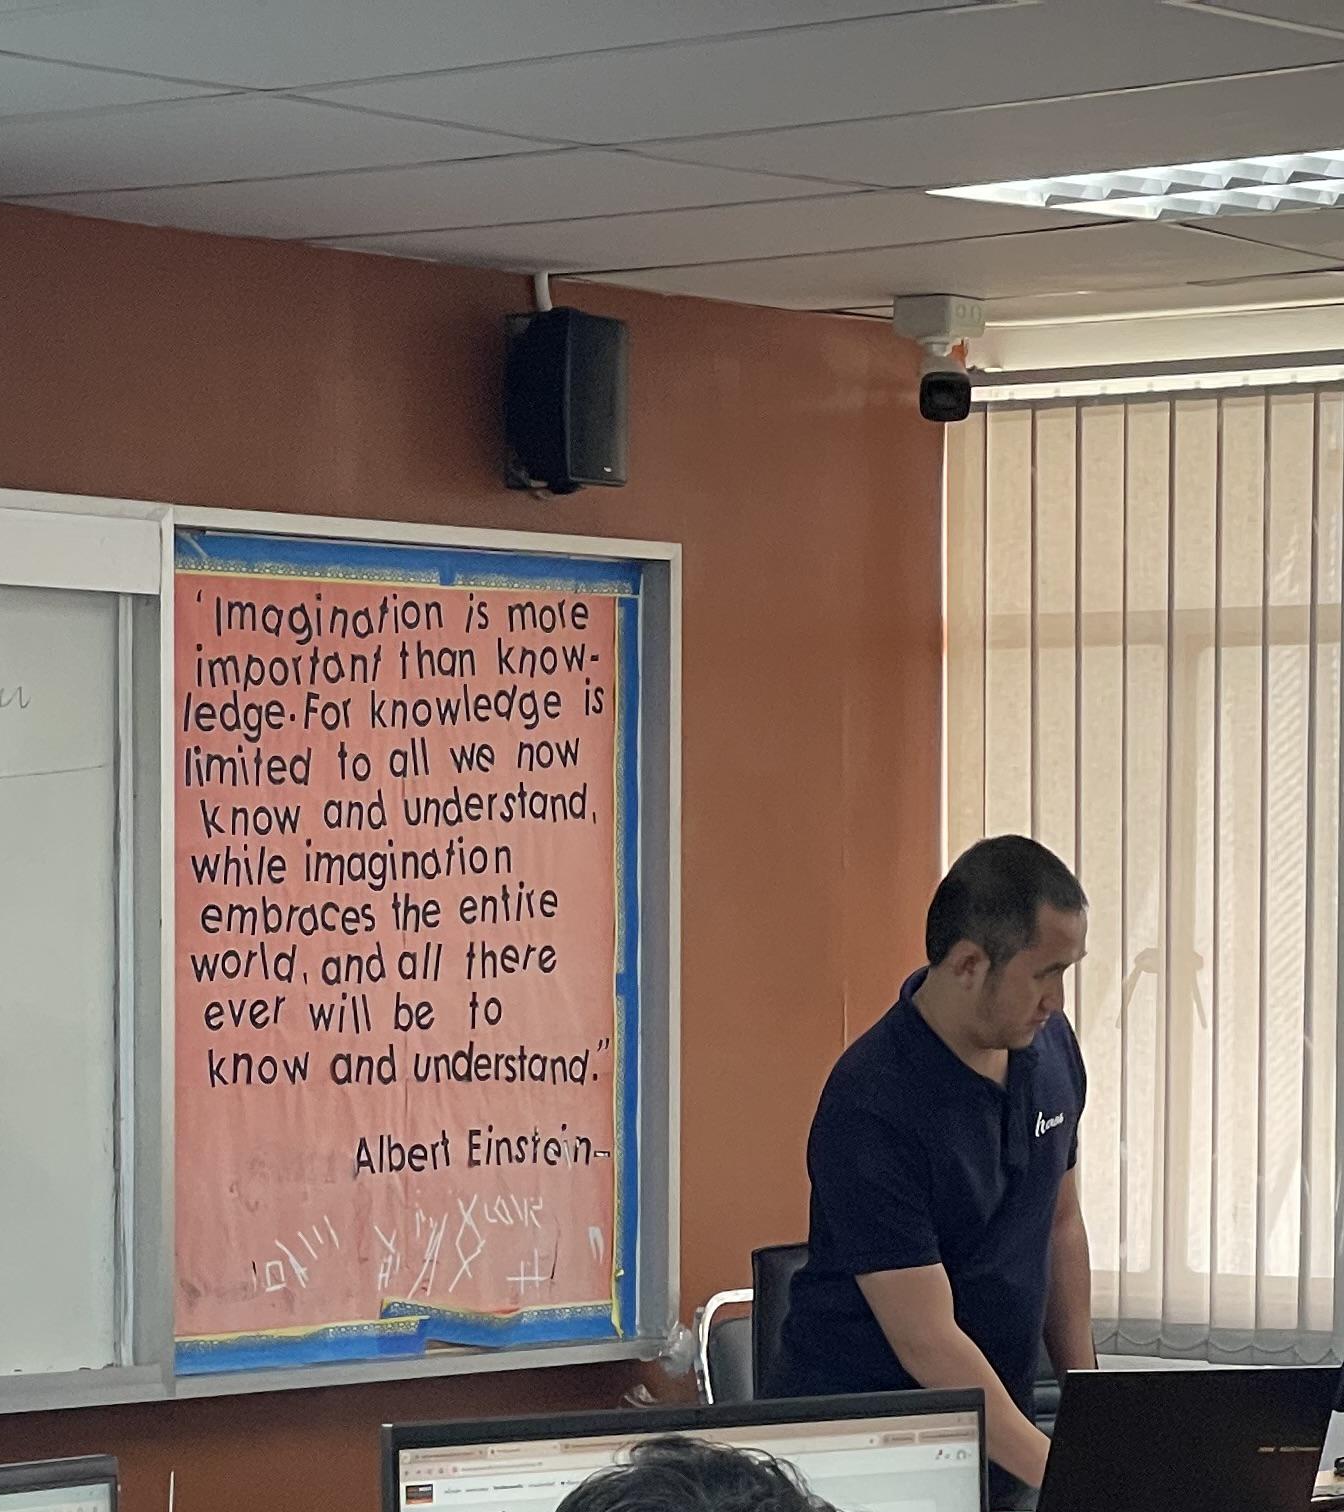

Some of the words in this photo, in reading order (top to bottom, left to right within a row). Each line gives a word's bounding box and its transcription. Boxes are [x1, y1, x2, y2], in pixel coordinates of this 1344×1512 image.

[465, 592, 489, 634] is
[507, 598, 589, 634] more
[196, 643, 382, 693] important
[399, 639, 476, 680] than
[497, 637, 600, 679] know-
[370, 683, 562, 730] knowledge
[585, 676, 605, 716] is
[185, 744, 312, 788] limited
[337, 741, 371, 782] to
[389, 736, 430, 778] all
[449, 742, 495, 774] we
[517, 737, 580, 772] now
[199, 799, 301, 839] know
[323, 788, 388, 831] and
[190, 843, 287, 888] while
[305, 835, 512, 892] imagination
[201, 895, 376, 937] embraces
[391, 892, 441, 933] the
[459, 880, 558, 925] entire
[321, 941, 386, 986] and
[397, 941, 443, 982] all
[466, 940, 557, 980] there
[204, 995, 286, 1032] ever
[308, 991, 372, 1035] will
[393, 991, 435, 1033] be
[469, 991, 502, 1030] to
[207, 1048, 310, 1088] know
[329, 1043, 397, 1086] and
[354, 1129, 450, 1177] Albert
